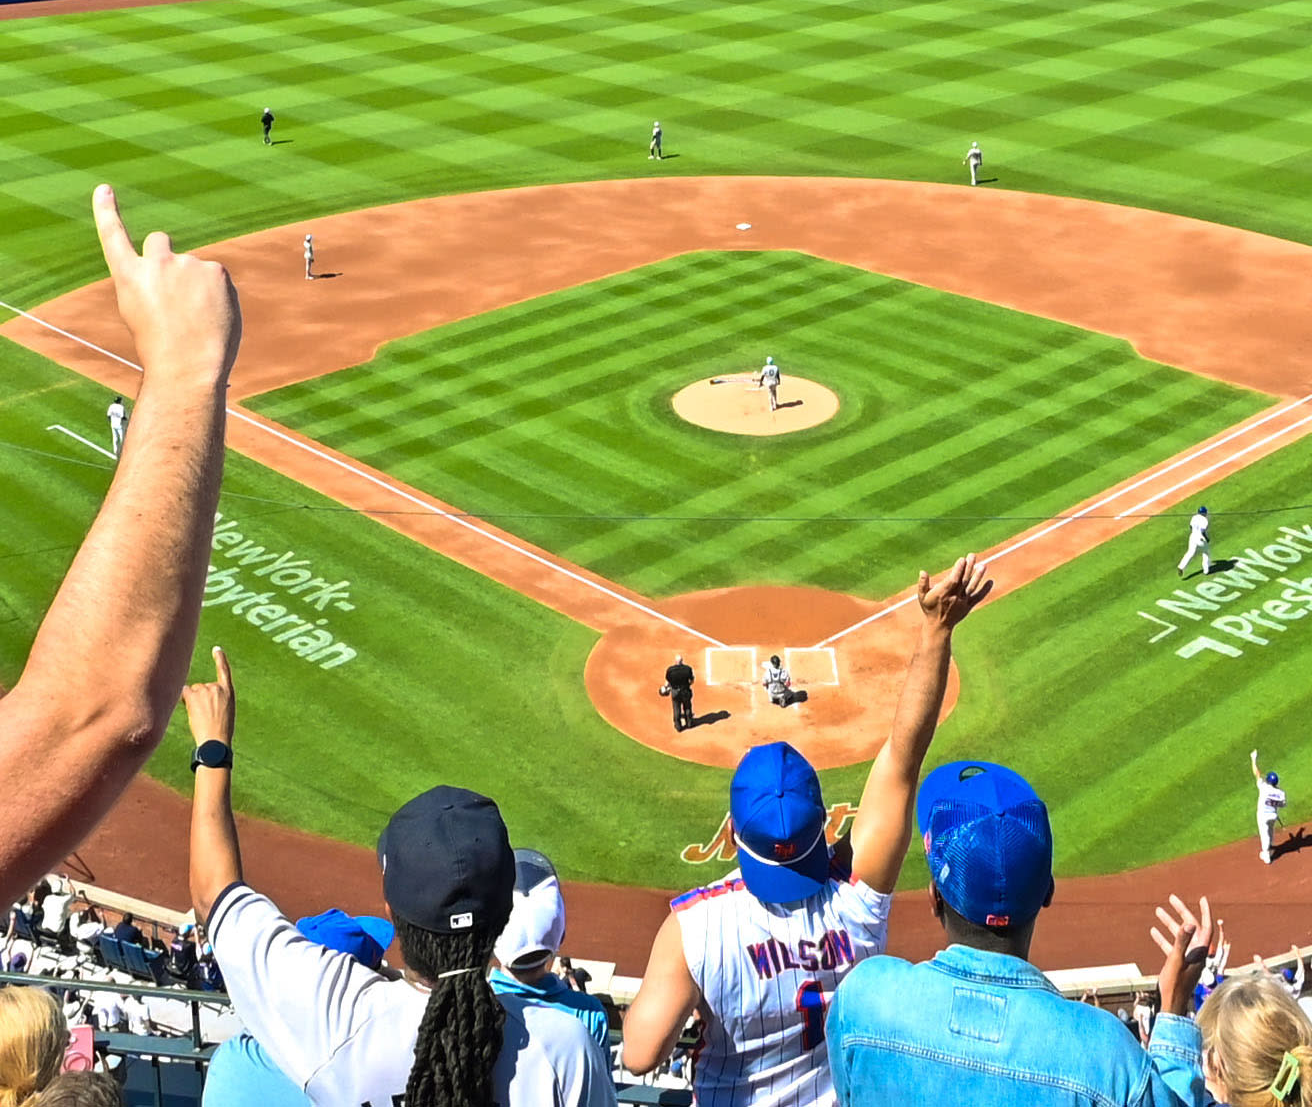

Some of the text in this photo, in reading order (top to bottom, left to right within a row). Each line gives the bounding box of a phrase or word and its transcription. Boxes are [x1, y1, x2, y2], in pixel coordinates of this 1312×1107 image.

[202, 565, 357, 670] byterian
[746, 929, 856, 980] WILSON
[795, 980, 826, 1051] 1
